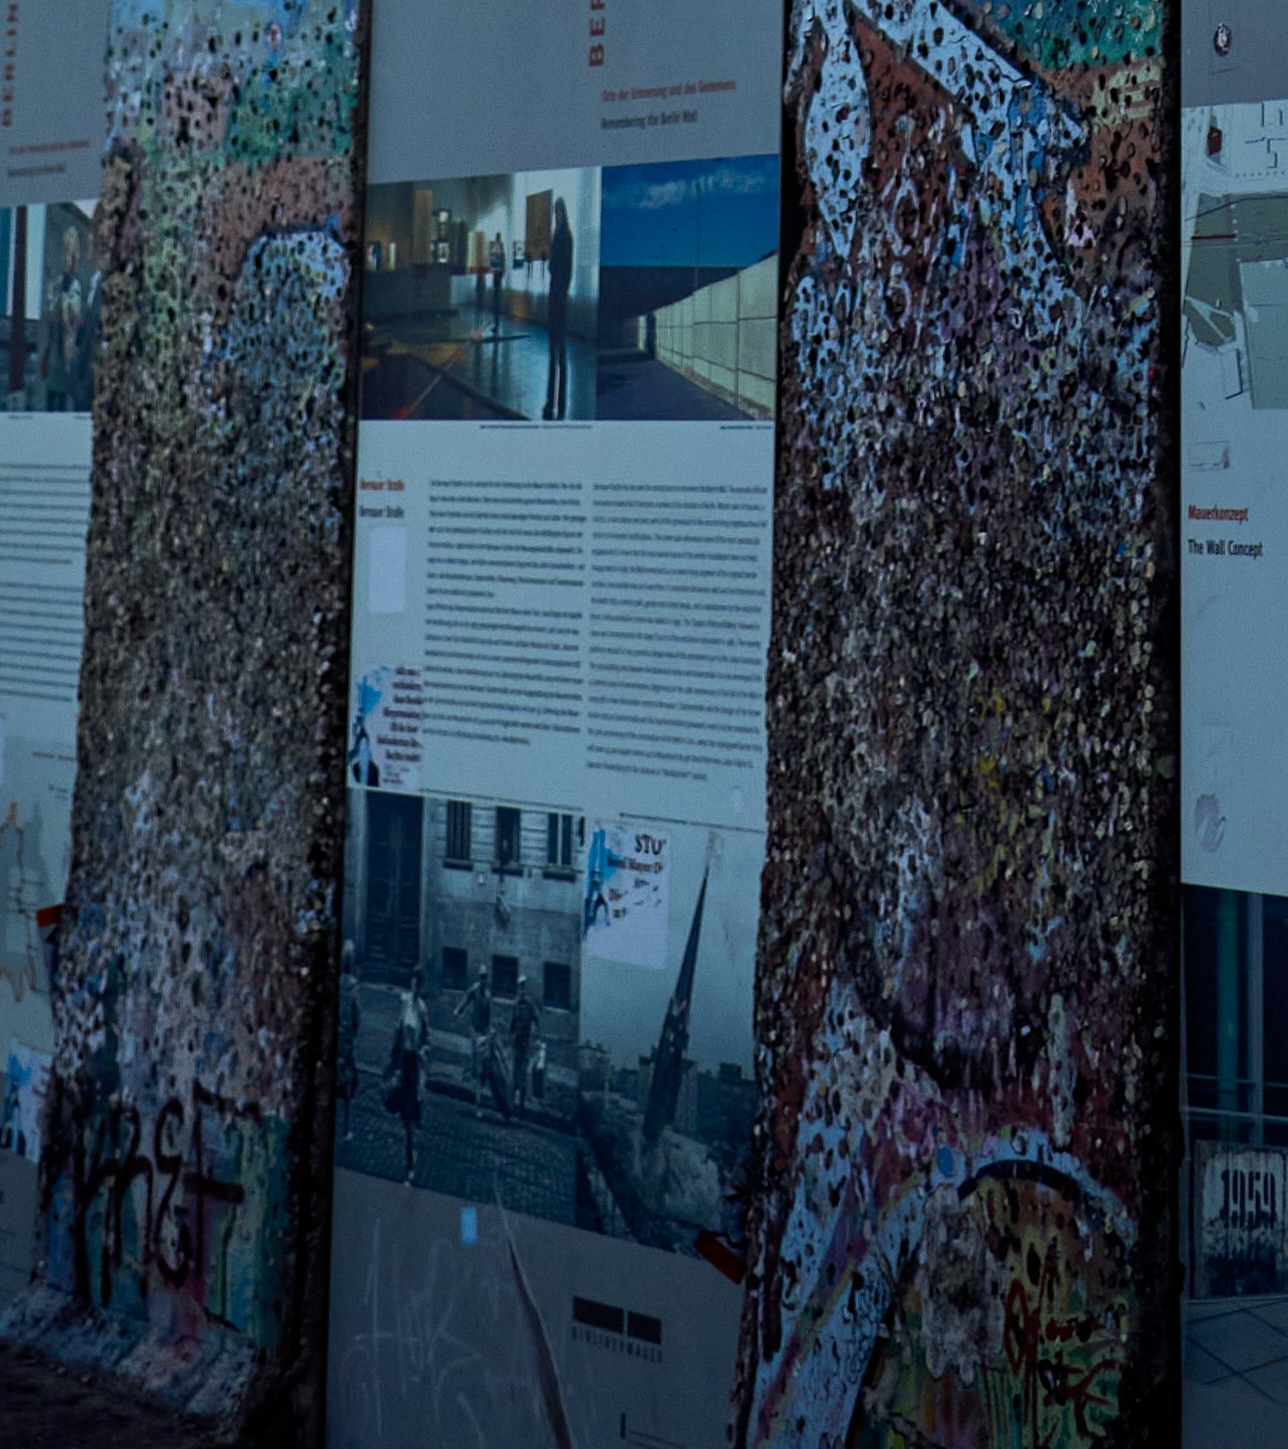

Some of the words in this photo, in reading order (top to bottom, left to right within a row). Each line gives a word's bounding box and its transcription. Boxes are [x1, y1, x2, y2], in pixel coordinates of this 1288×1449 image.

[1187, 504, 1249, 524] Mauerkonzept
[1187, 539, 1204, 555] The
[1205, 539, 1226, 556] Wall
[1227, 540, 1263, 560] Concept
[1220, 1167, 1278, 1230] 1959
